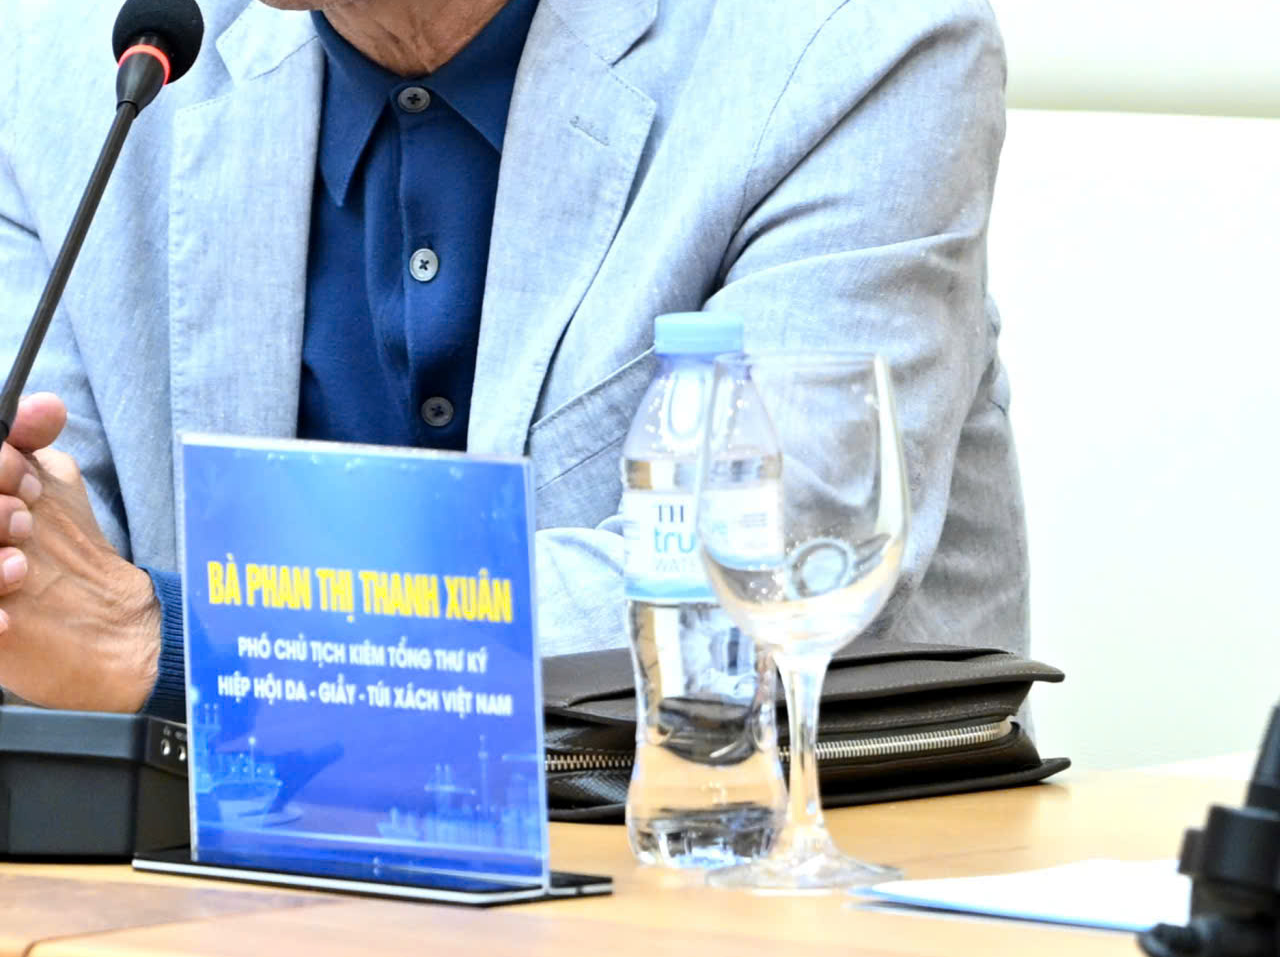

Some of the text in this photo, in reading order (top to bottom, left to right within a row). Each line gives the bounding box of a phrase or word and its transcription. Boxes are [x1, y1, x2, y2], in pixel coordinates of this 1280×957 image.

[207, 554, 513, 623] BÀ PHAN THỊ THANH XUÂN
[237, 633, 488, 673] PHÓ CHỦ TỊCH KIÊM TỔNG THƯ KÝ
[218, 671, 251, 701] HIỆP
[253, 673, 283, 704] HỘI
[284, 679, 308, 701] DA
[366, 680, 391, 708] TÚI
[393, 683, 440, 711] XÁCH
[441, 686, 473, 718] VIỆT
[475, 693, 513, 716] NAM
